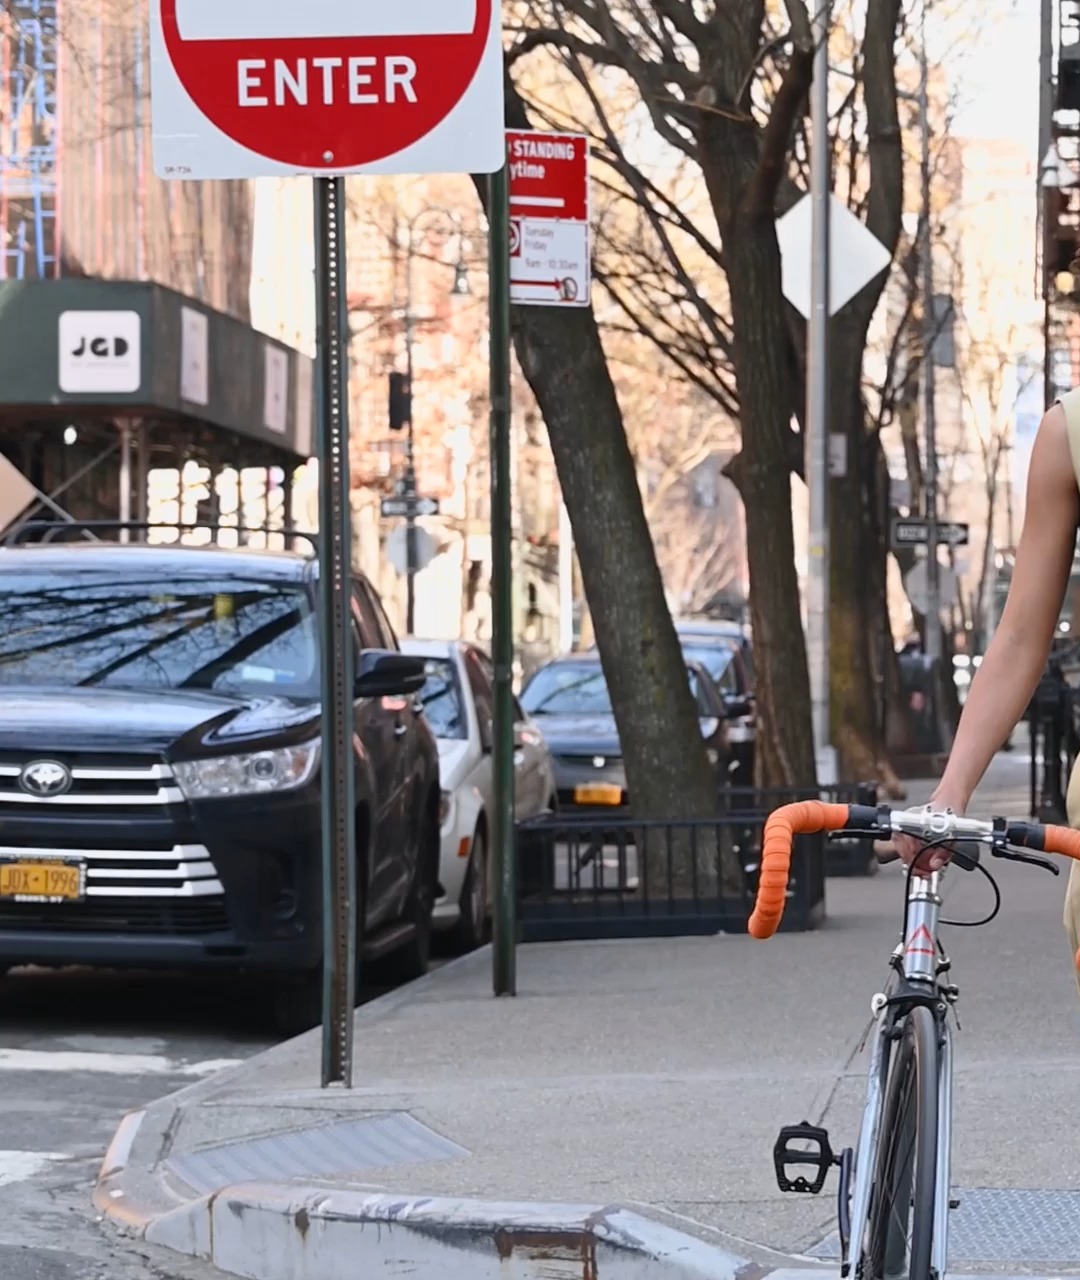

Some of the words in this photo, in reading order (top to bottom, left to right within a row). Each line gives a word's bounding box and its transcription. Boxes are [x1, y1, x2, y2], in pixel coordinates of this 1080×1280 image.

[237, 55, 418, 107] ENTER
[513, 139, 576, 161] STANDING
[510, 161, 546, 181] ytime
[72, 337, 128, 357] JGD
